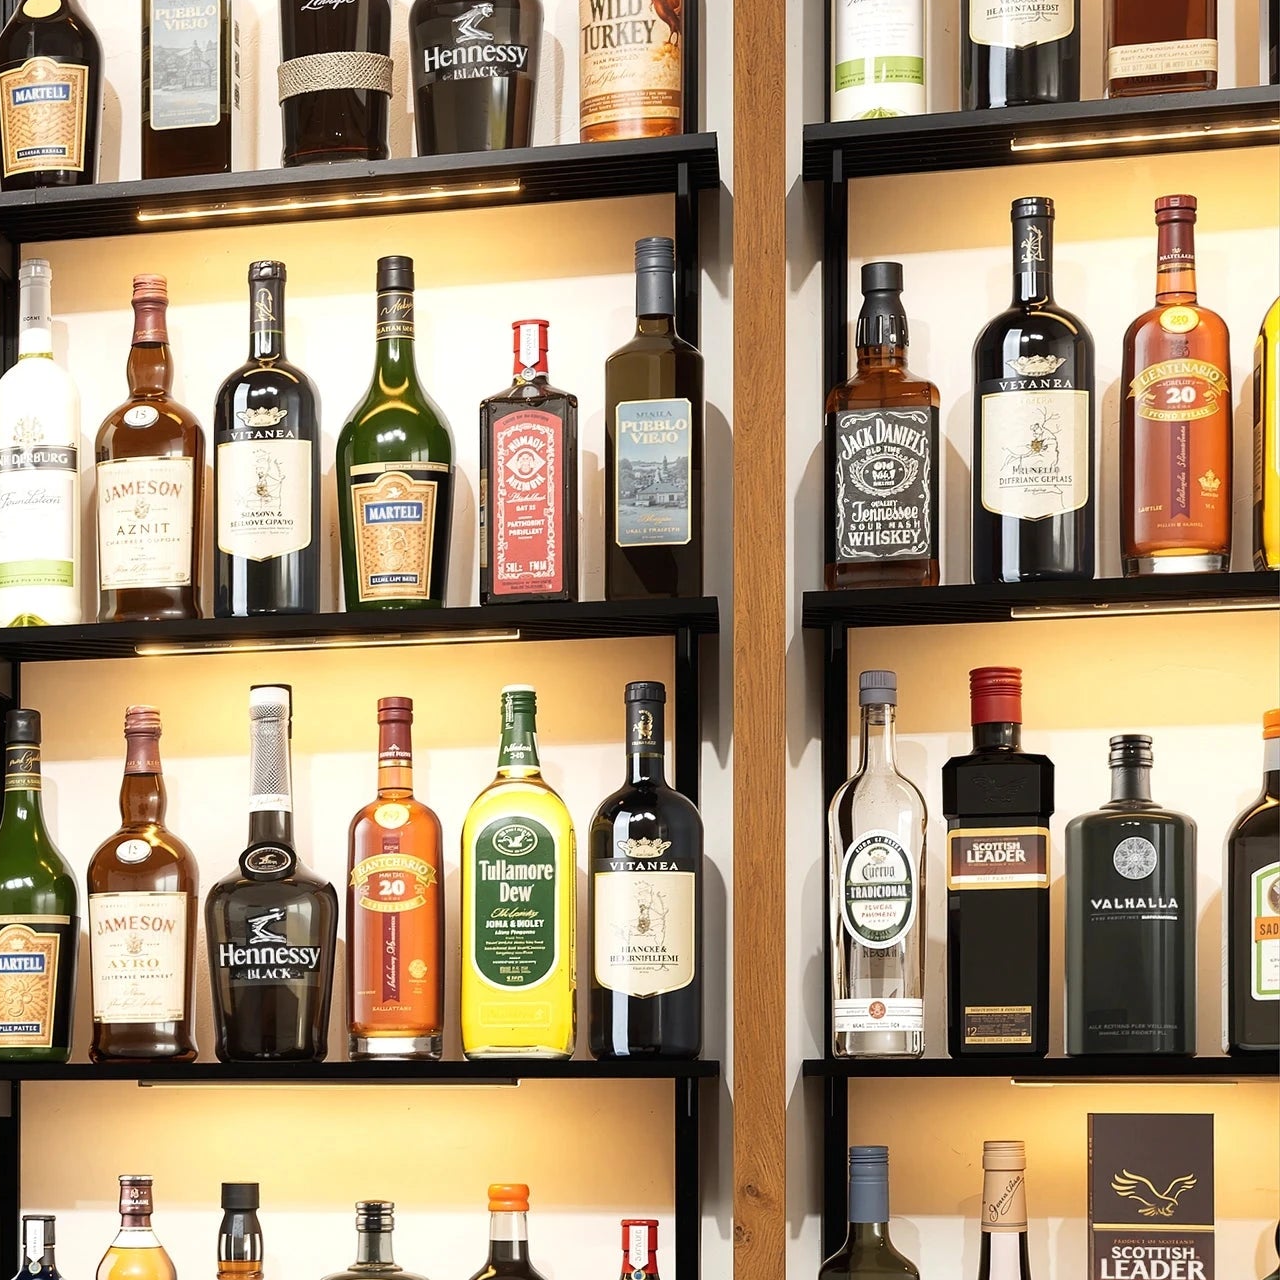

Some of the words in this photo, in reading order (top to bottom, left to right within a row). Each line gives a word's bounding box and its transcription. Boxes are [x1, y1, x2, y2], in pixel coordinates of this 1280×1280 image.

[155, 5, 217, 22] PUEBLO
[164, 17, 208, 32] VIEJO
[581, 18, 656, 55] TURKEY
[424, 44, 529, 74] Hennessy
[454, 66, 498, 80] BLACK
[15, 85, 68, 102] MARTELL
[1167, 386, 1196, 404] 20
[621, 419, 687, 433] PUEBLO
[631, 431, 679, 445] VIEJO
[842, 426, 873, 460] JACK
[875, 418, 929, 458] DANIEL'S
[105, 481, 182, 503] JAMESON
[369, 504, 421, 521] MARTELL
[852, 501, 918, 523] Tennessee
[848, 529, 921, 546] WHISKEY
[966, 848, 1026, 863] LEADER
[972, 842, 1021, 852] SCOTTISH
[479, 860, 554, 881] Tullamore
[609, 861, 679, 871] VITANEA
[379, 880, 406, 896] 20
[500, 883, 533, 902] Dew
[1091, 897, 1178, 910] VALHALLA
[97, 916, 176, 935] JAMESON
[219, 944, 320, 969] Hennessy
[1111, 1246, 1195, 1260] SCOTTISH
[1101, 1258, 1207, 1280] LEADER
